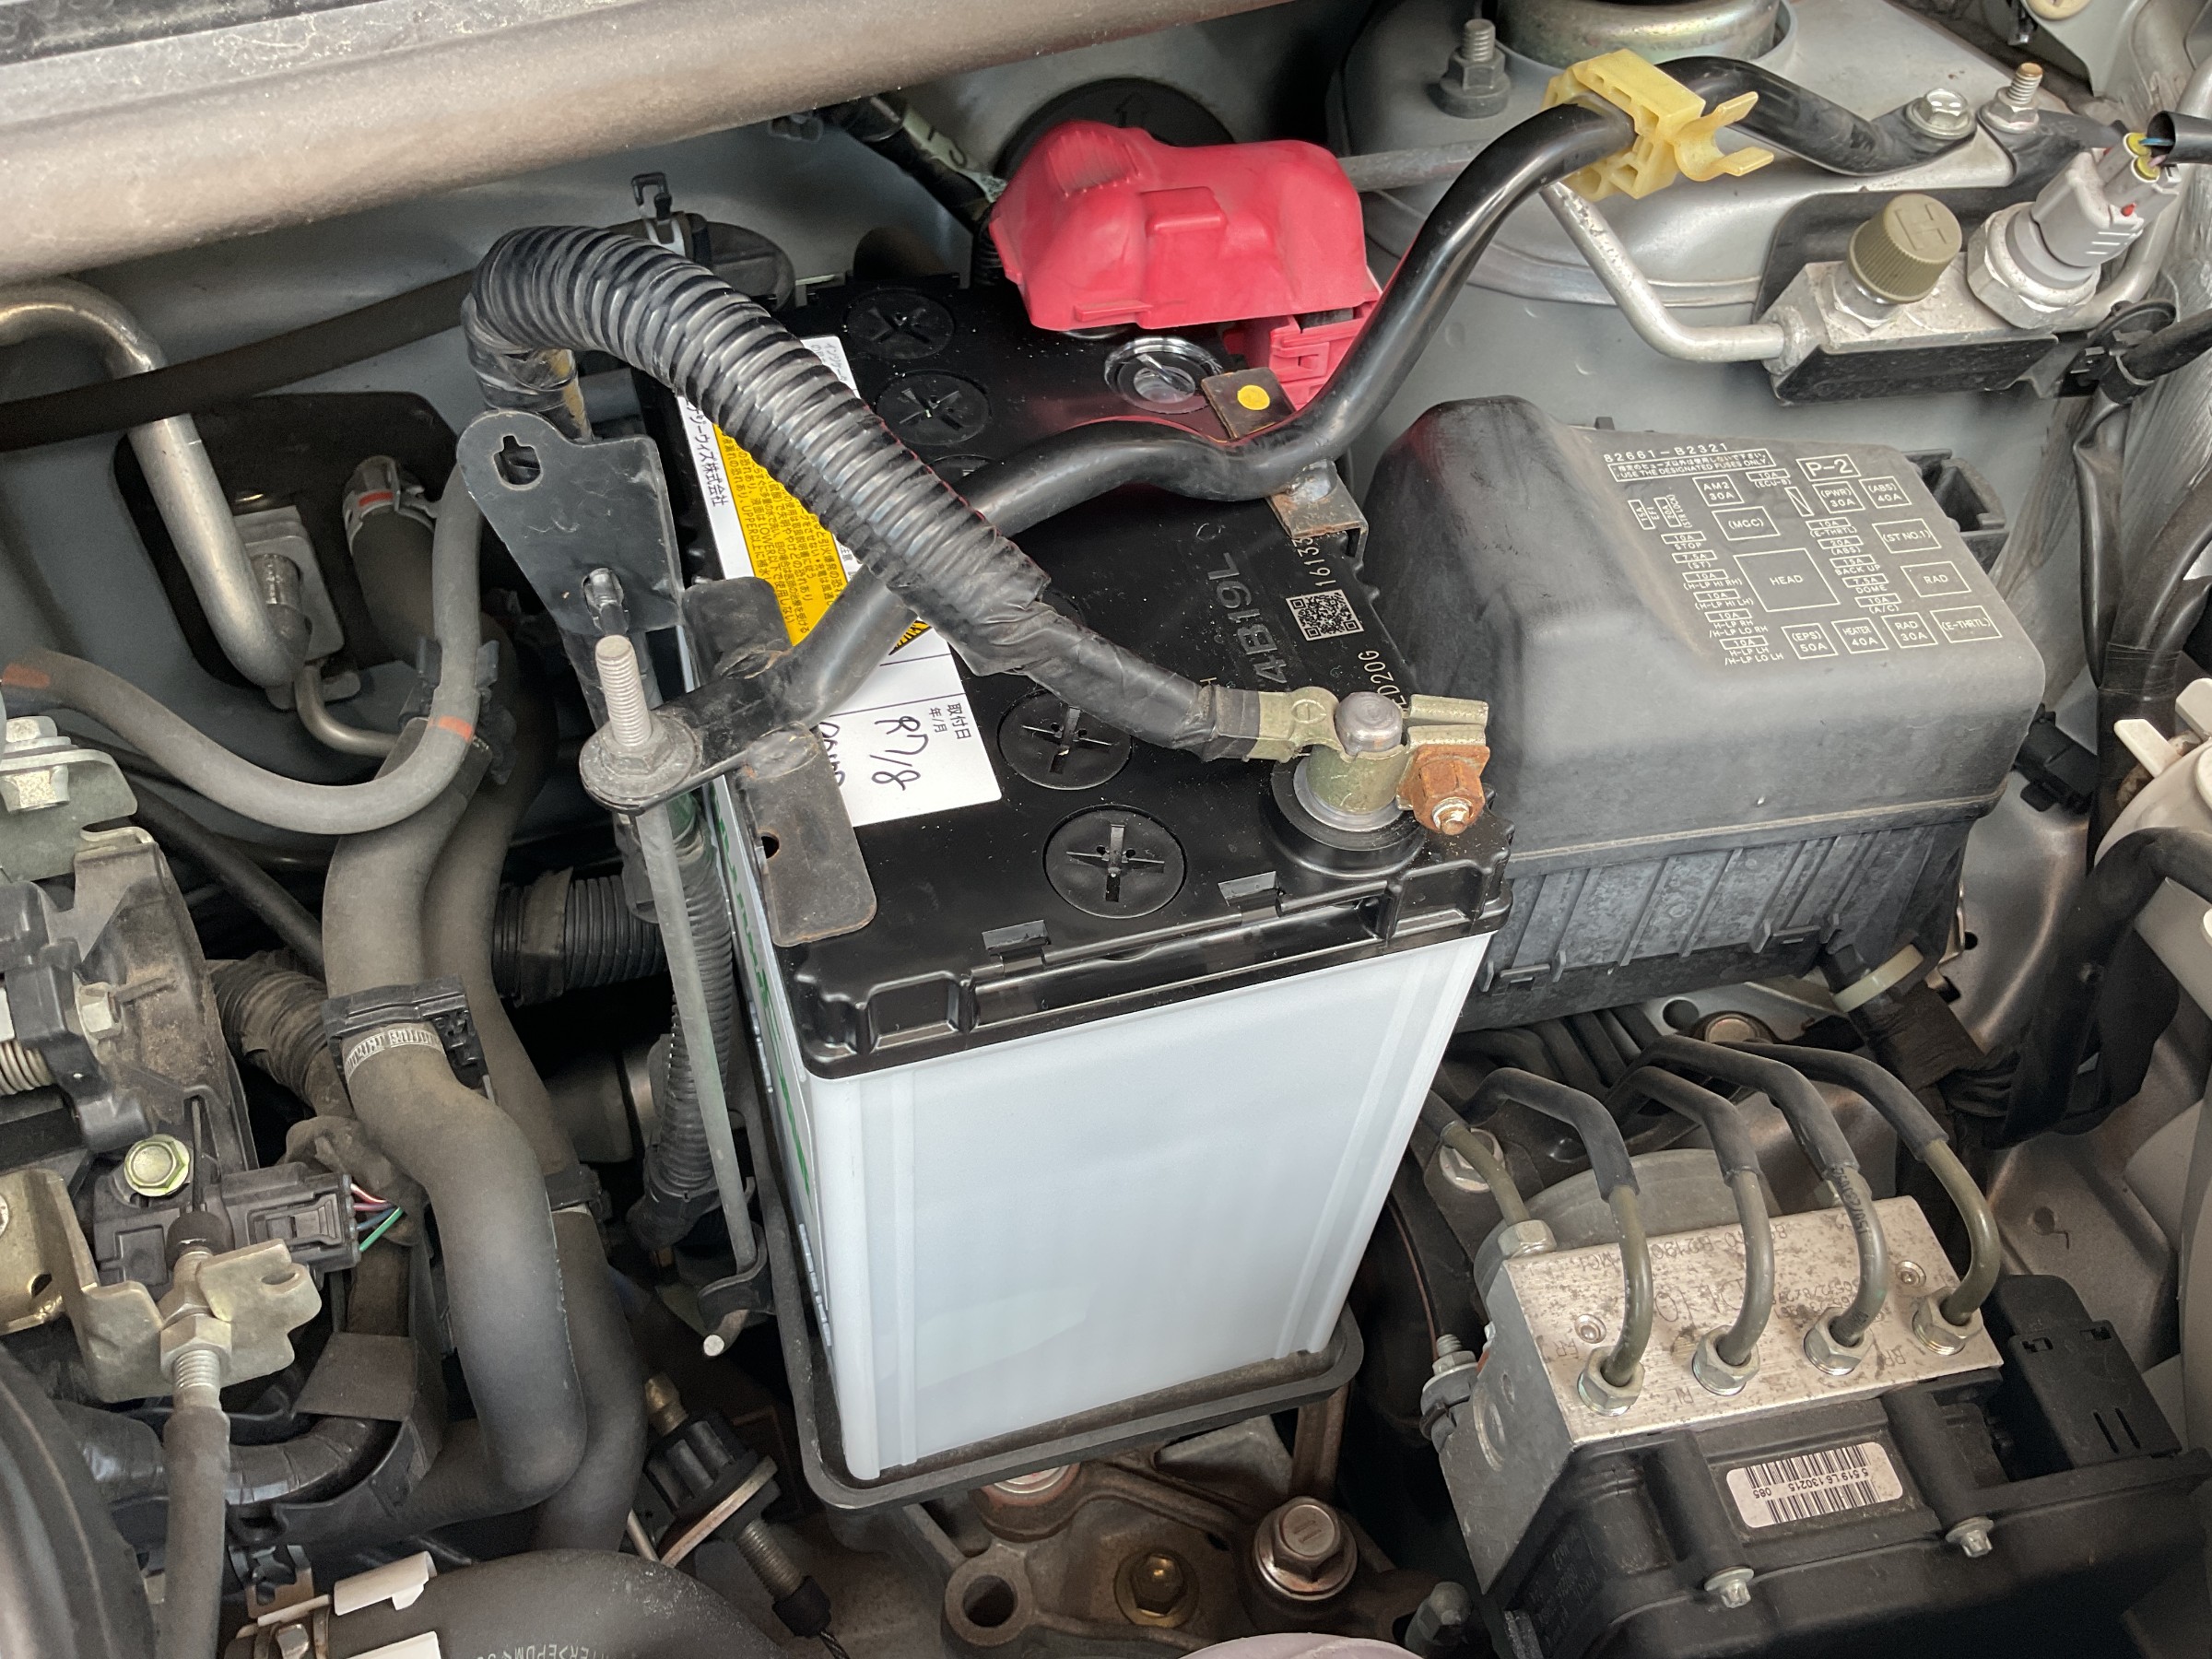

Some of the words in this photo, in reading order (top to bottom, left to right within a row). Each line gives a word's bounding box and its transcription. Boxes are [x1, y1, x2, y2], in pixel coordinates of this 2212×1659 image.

[686, 401, 729, 507] ナジーウィズ株式会社
[1620, 471, 1638, 479] USE
[1640, 469, 1658, 477] THE
[1659, 464, 1713, 475] DESIGNATED
[1714, 461, 1742, 469] FUSES
[1806, 458, 1853, 477] P-2
[1759, 471, 1779, 479] 10A
[1703, 482, 1730, 491] AM2
[1755, 478, 1792, 488] (ECU-B)
[1868, 483, 1897, 493] (ABS)
[1709, 492, 1735, 500] 30A
[1821, 488, 1852, 498] (PWR)
[1877, 493, 1902, 502] 40A
[1830, 499, 1855, 507] 30A
[1647, 507, 1660, 521] EFI
[1728, 517, 1764, 530] (MGC)
[1809, 525, 1857, 537] (E-THRTL)
[1674, 542, 1702, 550] STOP
[1830, 538, 1851, 547] 20A
[1831, 546, 1861, 556] (ABS)
[1683, 553, 1706, 561] 7.5A
[1688, 561, 1712, 570] (ST)
[1835, 566, 1865, 575] BACK
[1867, 564, 1881, 572] UP
[1770, 575, 1804, 585] HEAD
[1853, 577, 1878, 585] 7.5A
[1924, 574, 1948, 584] RAD
[1683, 582, 1711, 591] (H-LP
[1855, 584, 1888, 594] DOME
[1695, 602, 1723, 610] (H-LP
[1737, 597, 1754, 606] LH)
[1868, 596, 1889, 605] 10A
[1869, 605, 1900, 614] (A/C)
[1714, 621, 1737, 629] H-LP
[1895, 620, 1919, 630] RAD
[1941, 618, 1992, 631] (E-THRTL)
[1709, 629, 1736, 639] /H-LP
[1792, 630, 1822, 641] (EPS)
[1842, 626, 1872, 636] HEATER
[1900, 631, 1928, 641] 30A
[1852, 637, 1878, 647] 40A
[1729, 649, 1753, 657] H-LP
[1801, 643, 1828, 653] 50A
[1724, 656, 1752, 665] /H-LP
[947, 702, 972, 741] 取付日
[1841, 1469, 1860, 1481] 519
[1861, 1467, 1869, 1477] 5
[1788, 1477, 1824, 1491] 130215
[1826, 1474, 1840, 1485] L6
[1752, 1487, 1771, 1499] 085
